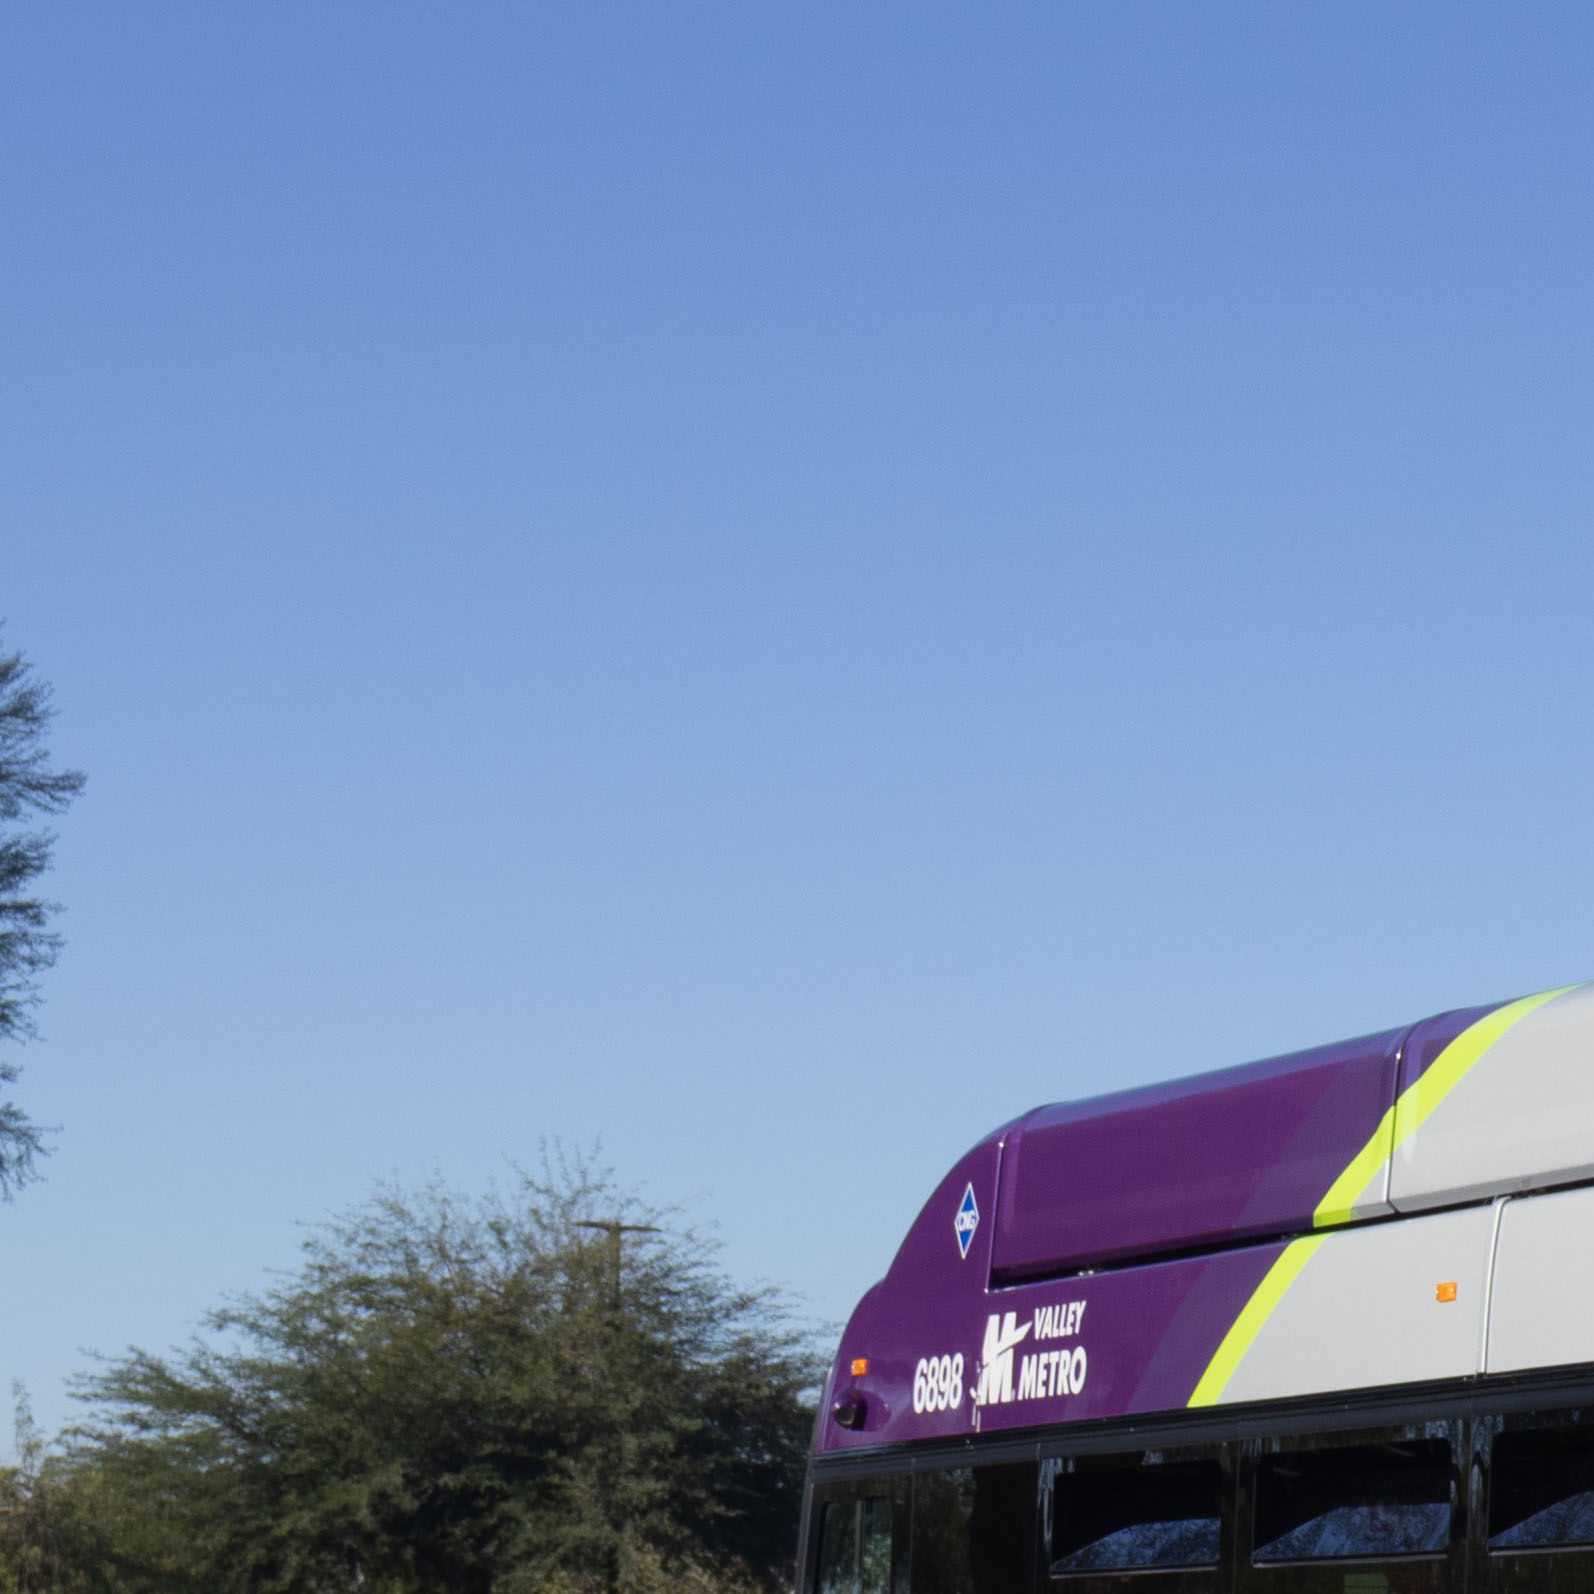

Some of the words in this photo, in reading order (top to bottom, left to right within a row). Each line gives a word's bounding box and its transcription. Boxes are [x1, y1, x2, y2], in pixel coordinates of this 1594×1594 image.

[1034, 1299, 1087, 1341] VALLEY
[913, 1352, 964, 1414] 6898
[1017, 1345, 1087, 1401] METRO
